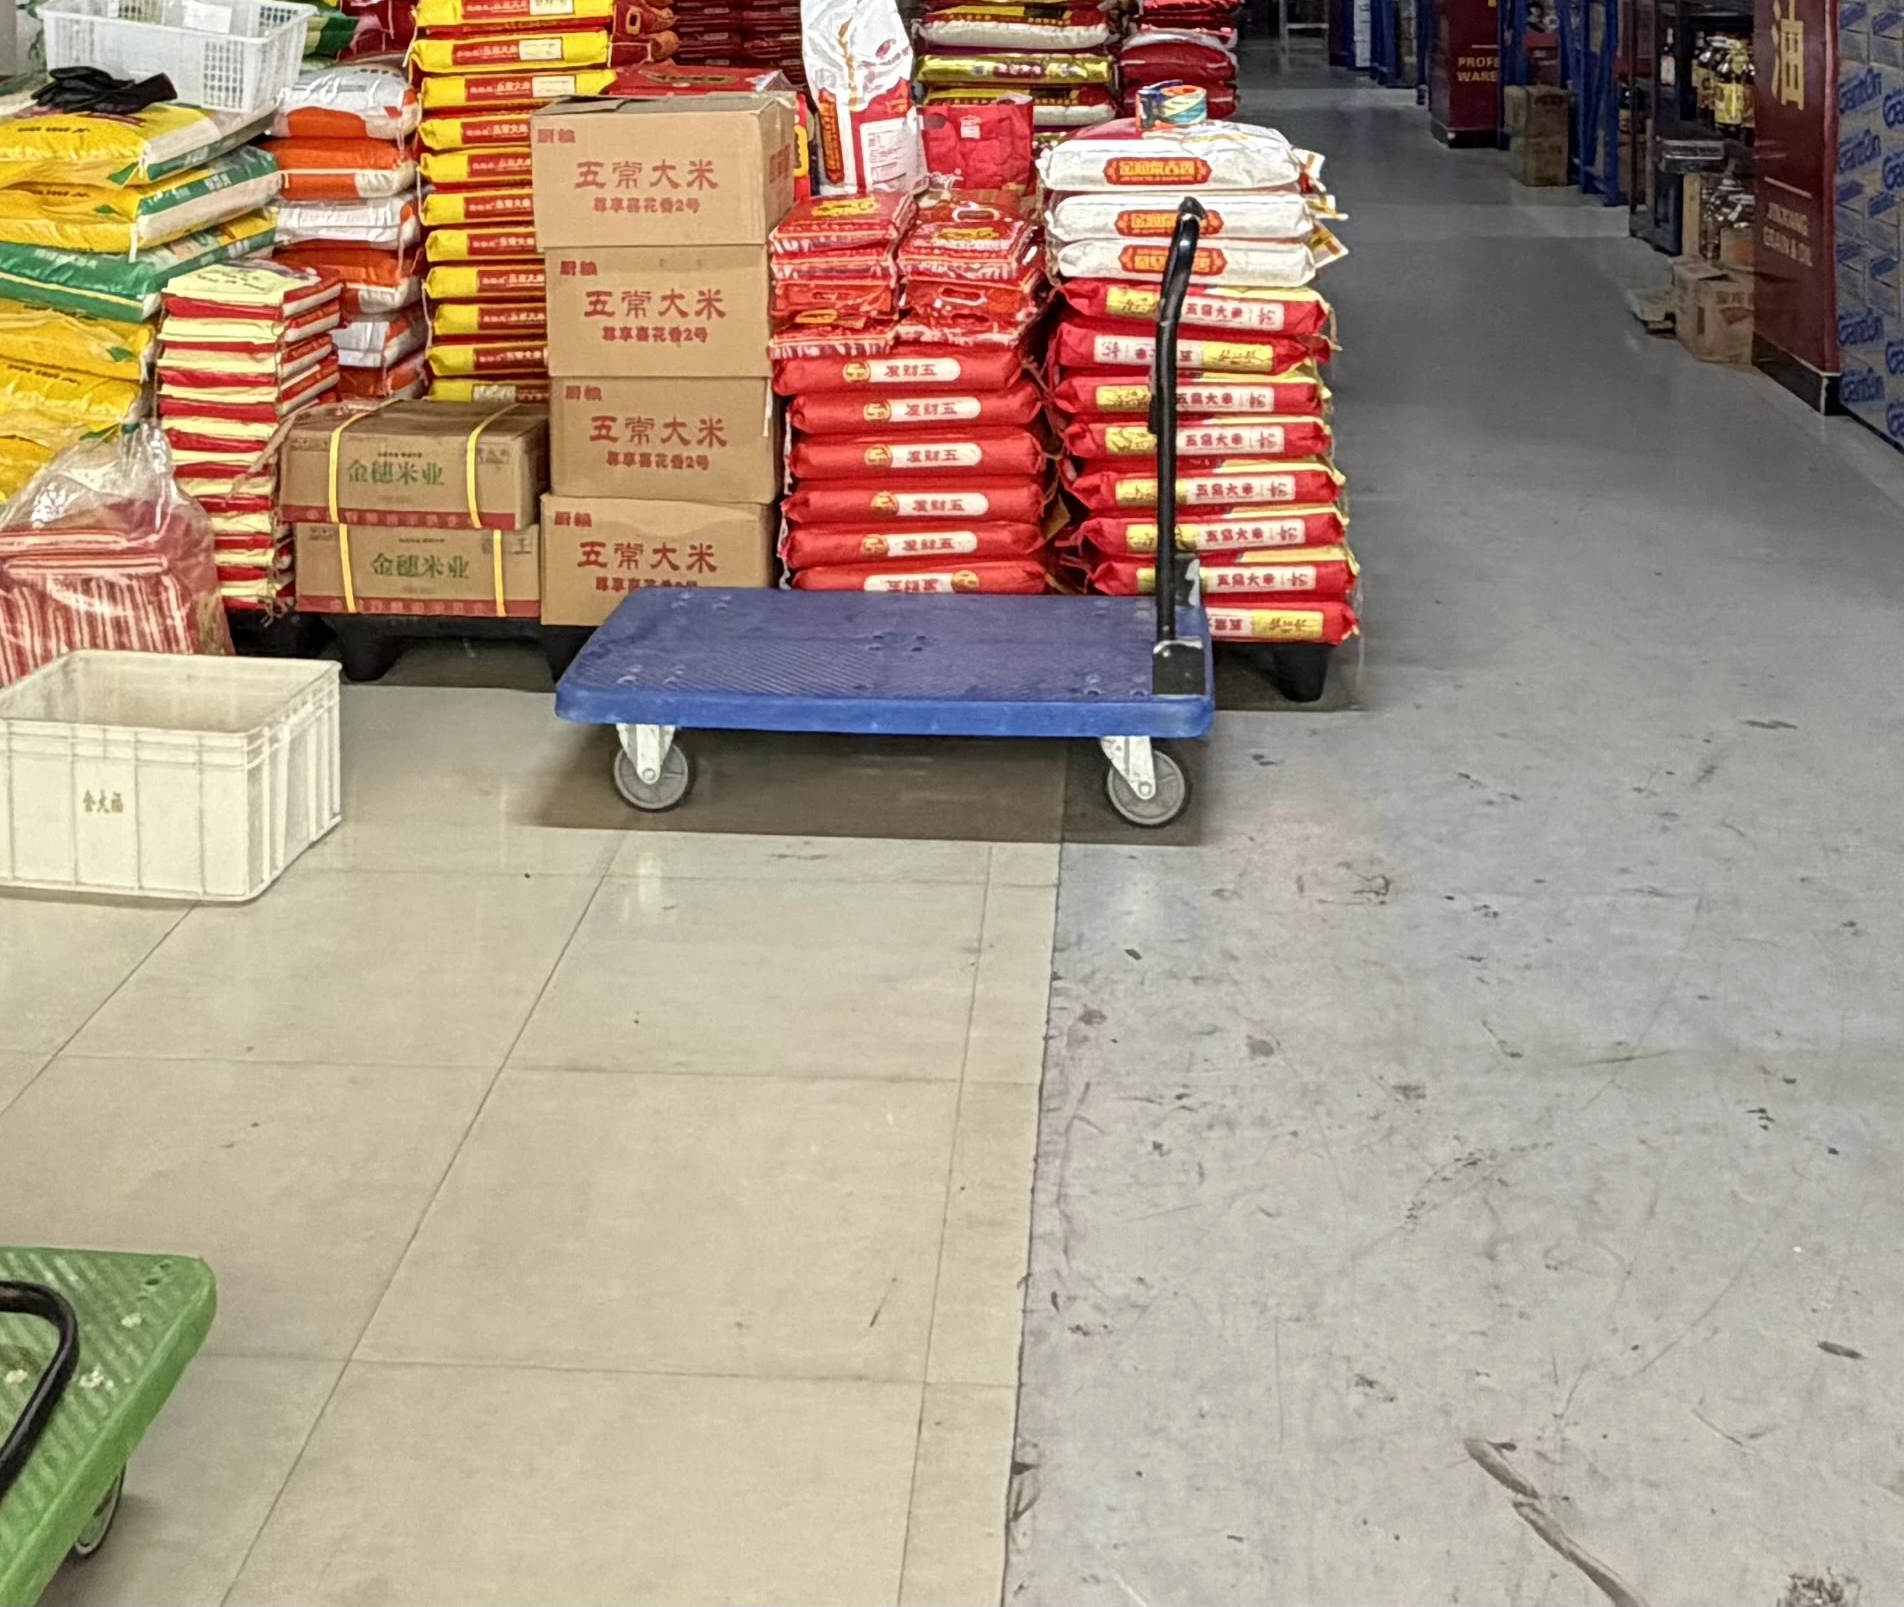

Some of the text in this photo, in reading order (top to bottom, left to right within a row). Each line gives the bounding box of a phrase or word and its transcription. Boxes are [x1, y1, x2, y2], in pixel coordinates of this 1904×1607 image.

[574, 159, 718, 191] 五常大米
[584, 288, 726, 320] 五常大米
[590, 415, 727, 448] 五常大米
[347, 459, 444, 485] 金穗米业
[371, 552, 470, 578] 金穗米业
[577, 541, 717, 573] 五常大米
